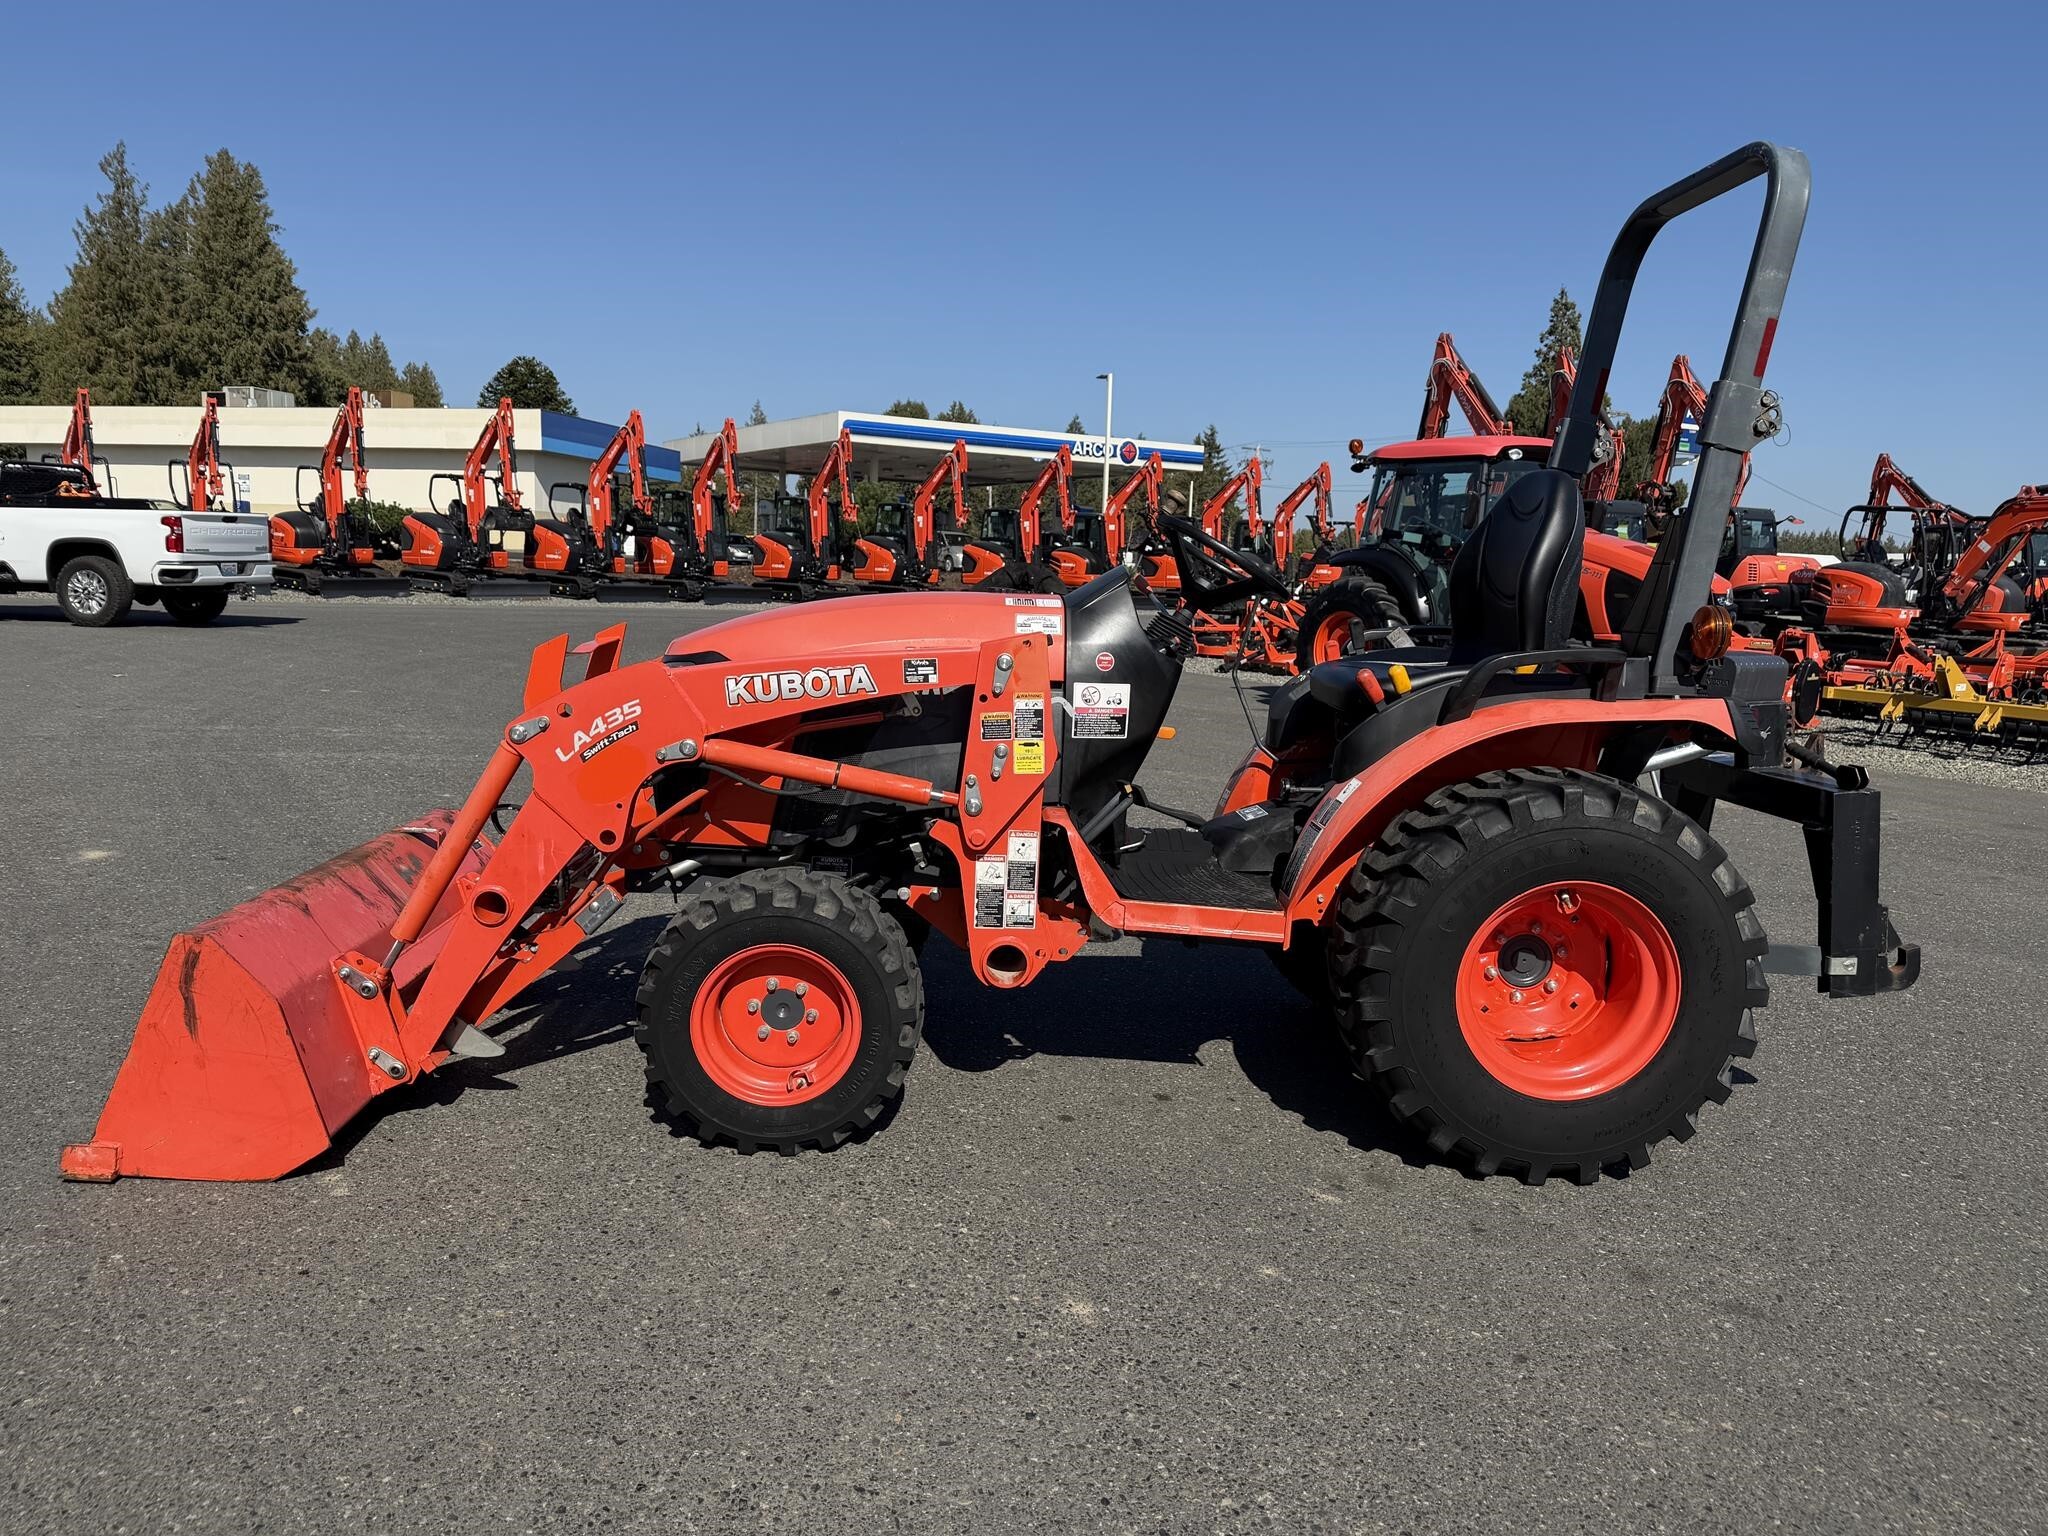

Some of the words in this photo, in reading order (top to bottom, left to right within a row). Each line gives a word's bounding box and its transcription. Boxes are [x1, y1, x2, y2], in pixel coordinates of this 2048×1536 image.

[1072, 441, 1114, 457] ARCO
[191, 527, 265, 537] CHEVROLET
[726, 665, 877, 706] KUBOTA
[555, 699, 641, 762] LA435
[583, 724, 636, 760] Swift-Tach
